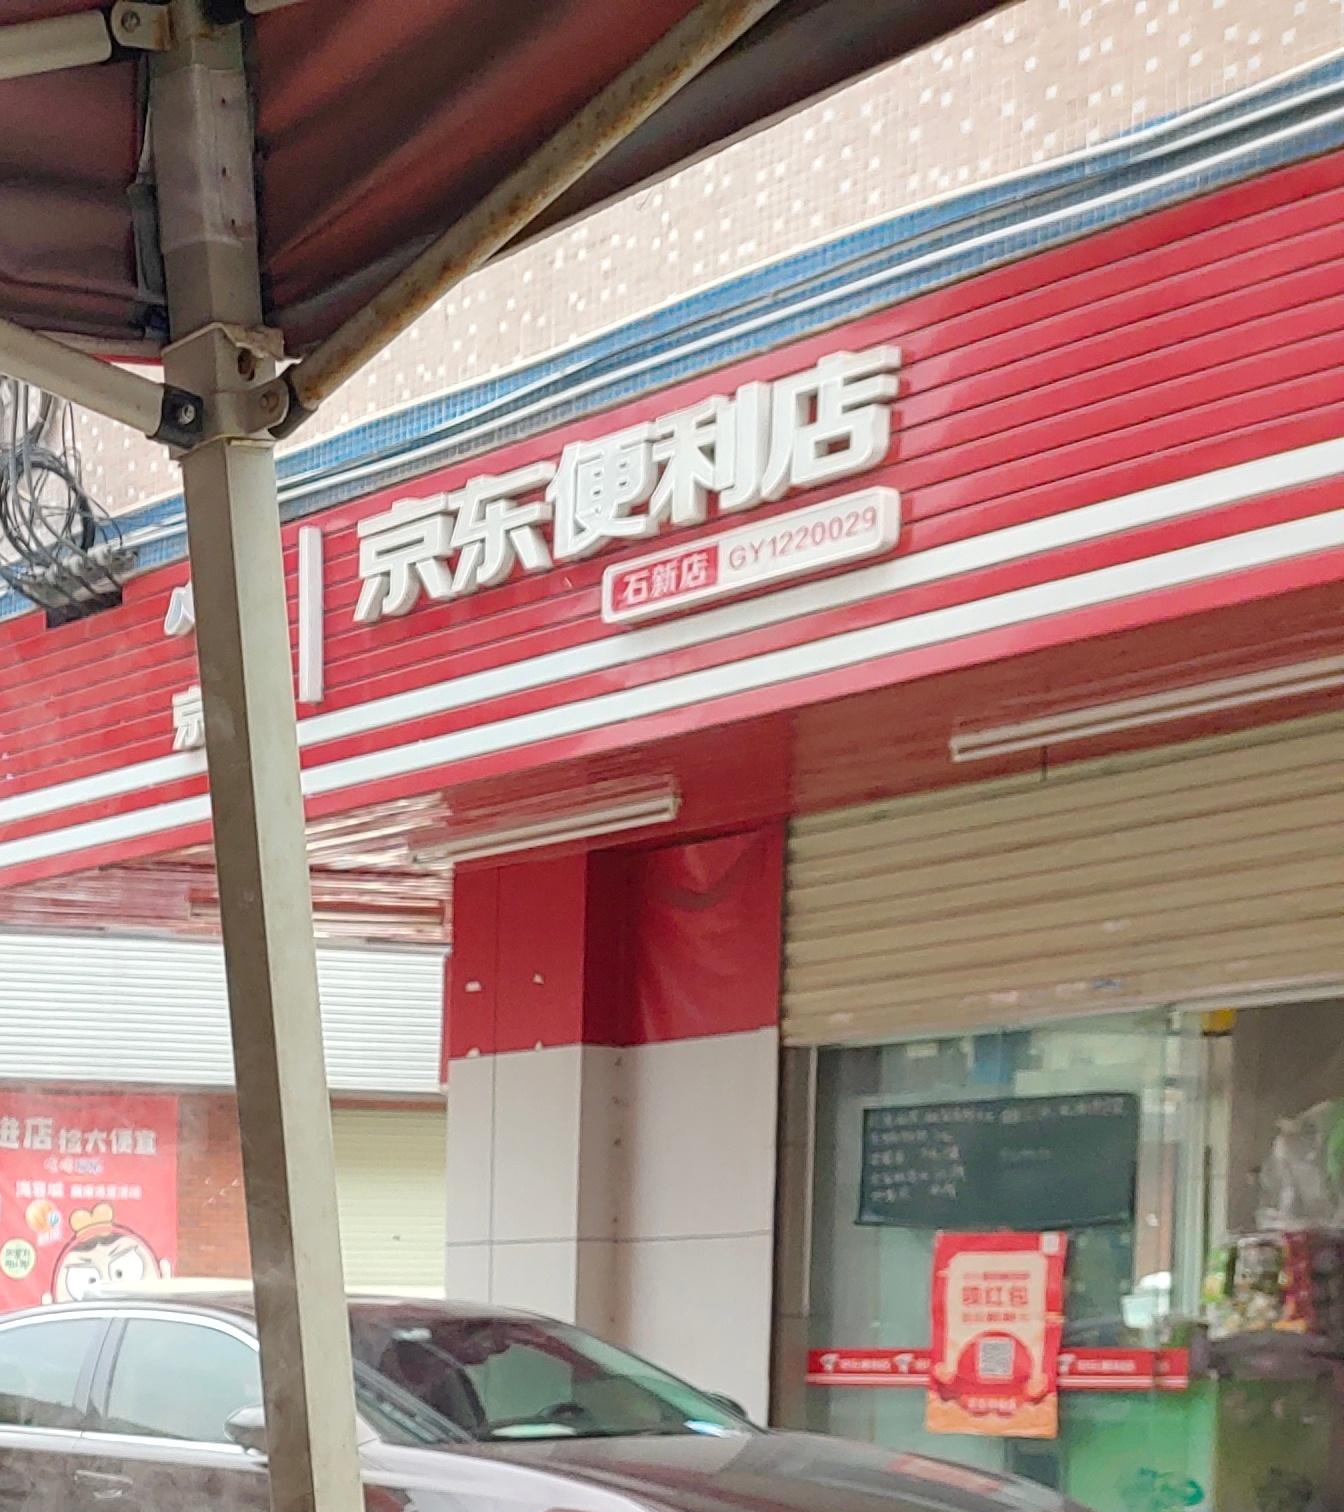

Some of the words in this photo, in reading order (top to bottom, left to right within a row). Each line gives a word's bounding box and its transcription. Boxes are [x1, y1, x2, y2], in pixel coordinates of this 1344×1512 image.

[353, 346, 902, 623] 京东便利店
[621, 551, 710, 607] 石新店
[728, 506, 878, 571] GY1220029
